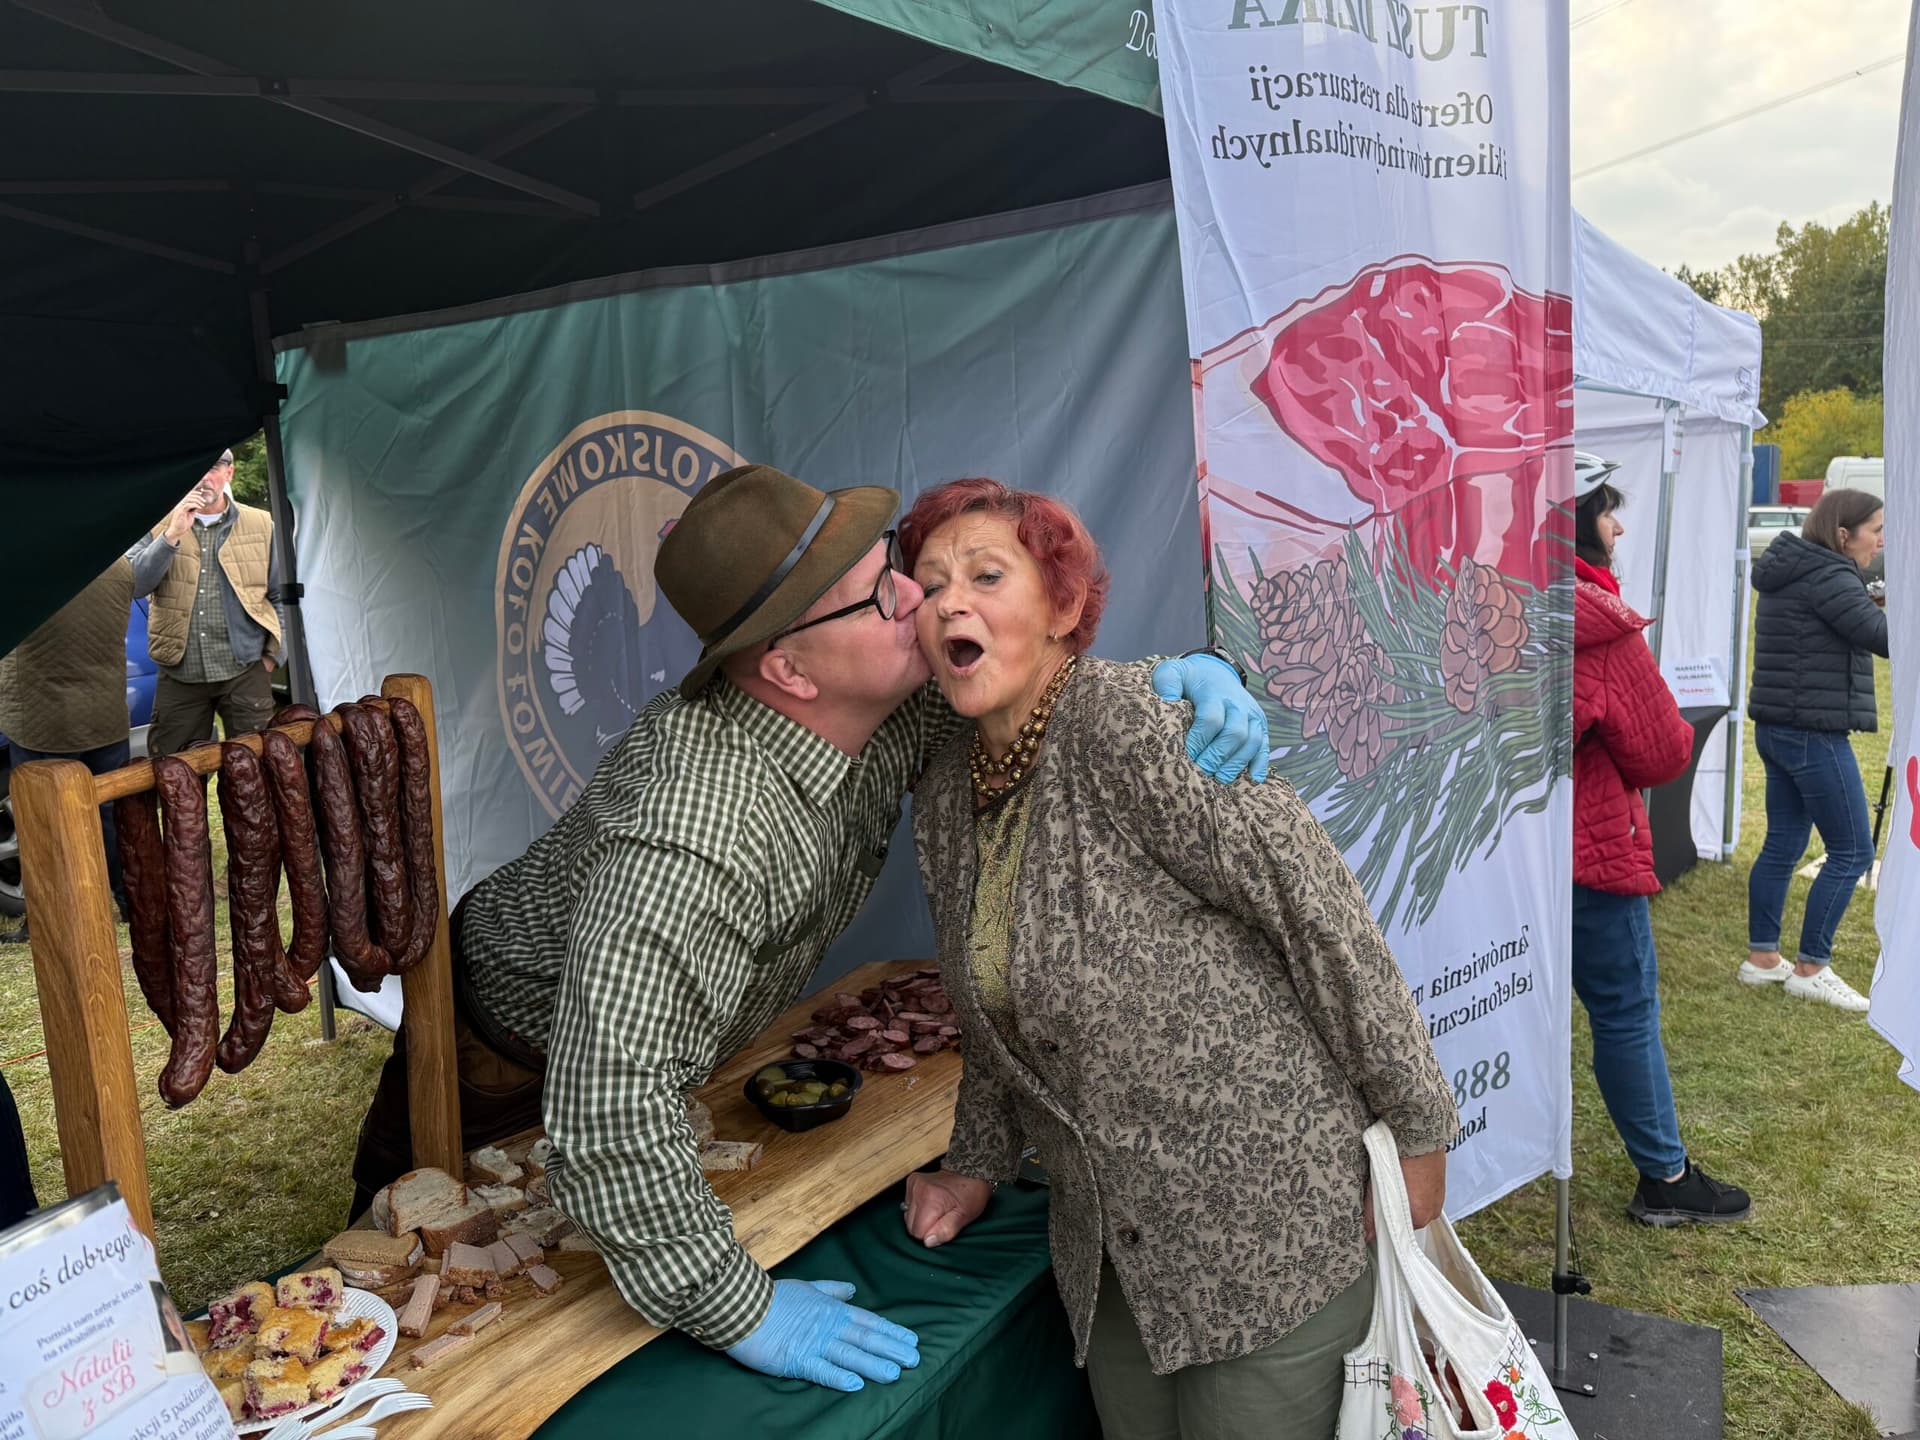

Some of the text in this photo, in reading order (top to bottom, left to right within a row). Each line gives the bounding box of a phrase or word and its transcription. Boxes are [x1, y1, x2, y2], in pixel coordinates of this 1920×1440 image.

[9, 1223, 136, 1310] coś dobrego!
[160, 1408, 171, 1424] 5
